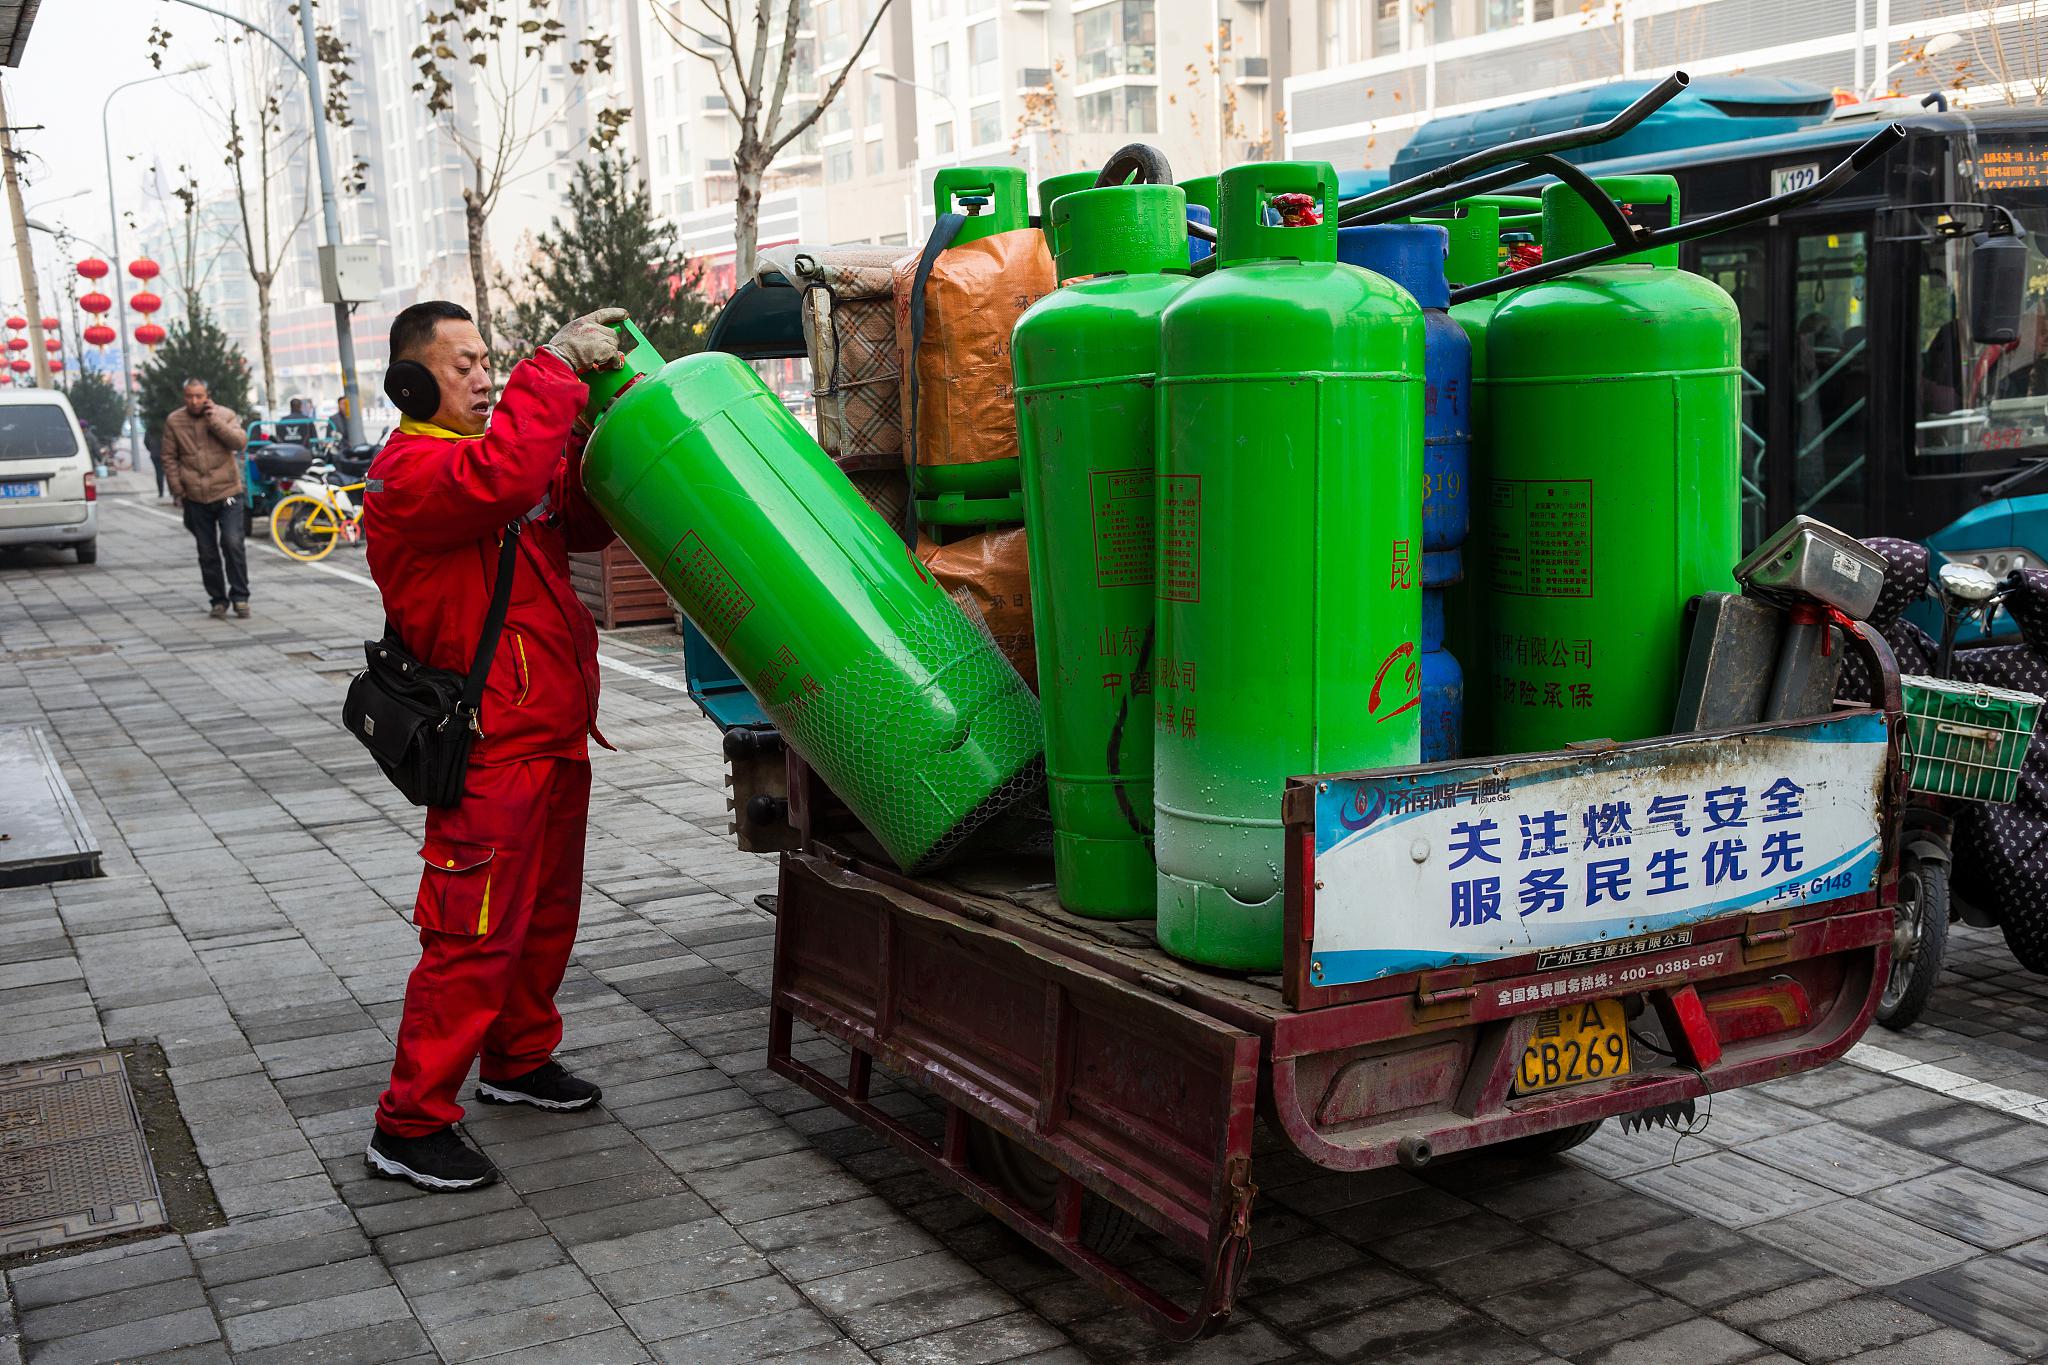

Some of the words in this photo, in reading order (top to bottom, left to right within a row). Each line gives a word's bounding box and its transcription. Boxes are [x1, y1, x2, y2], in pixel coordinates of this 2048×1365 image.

[1780, 168, 1814, 194] K122
[1388, 780, 1478, 816] 济南煤气
[1480, 794, 1496, 804] Blue
[1497, 793, 1511, 802] Gas
[1448, 777, 1805, 871] 关注燃气安全
[1449, 830, 1804, 929] 服务民生优先
[1811, 872, 1852, 895] G148
[1541, 930, 1691, 968] 广州五羊摩托有限公司
[1619, 952, 1725, 982] 400-0388-697
[1521, 1032, 1625, 1088] CB269
